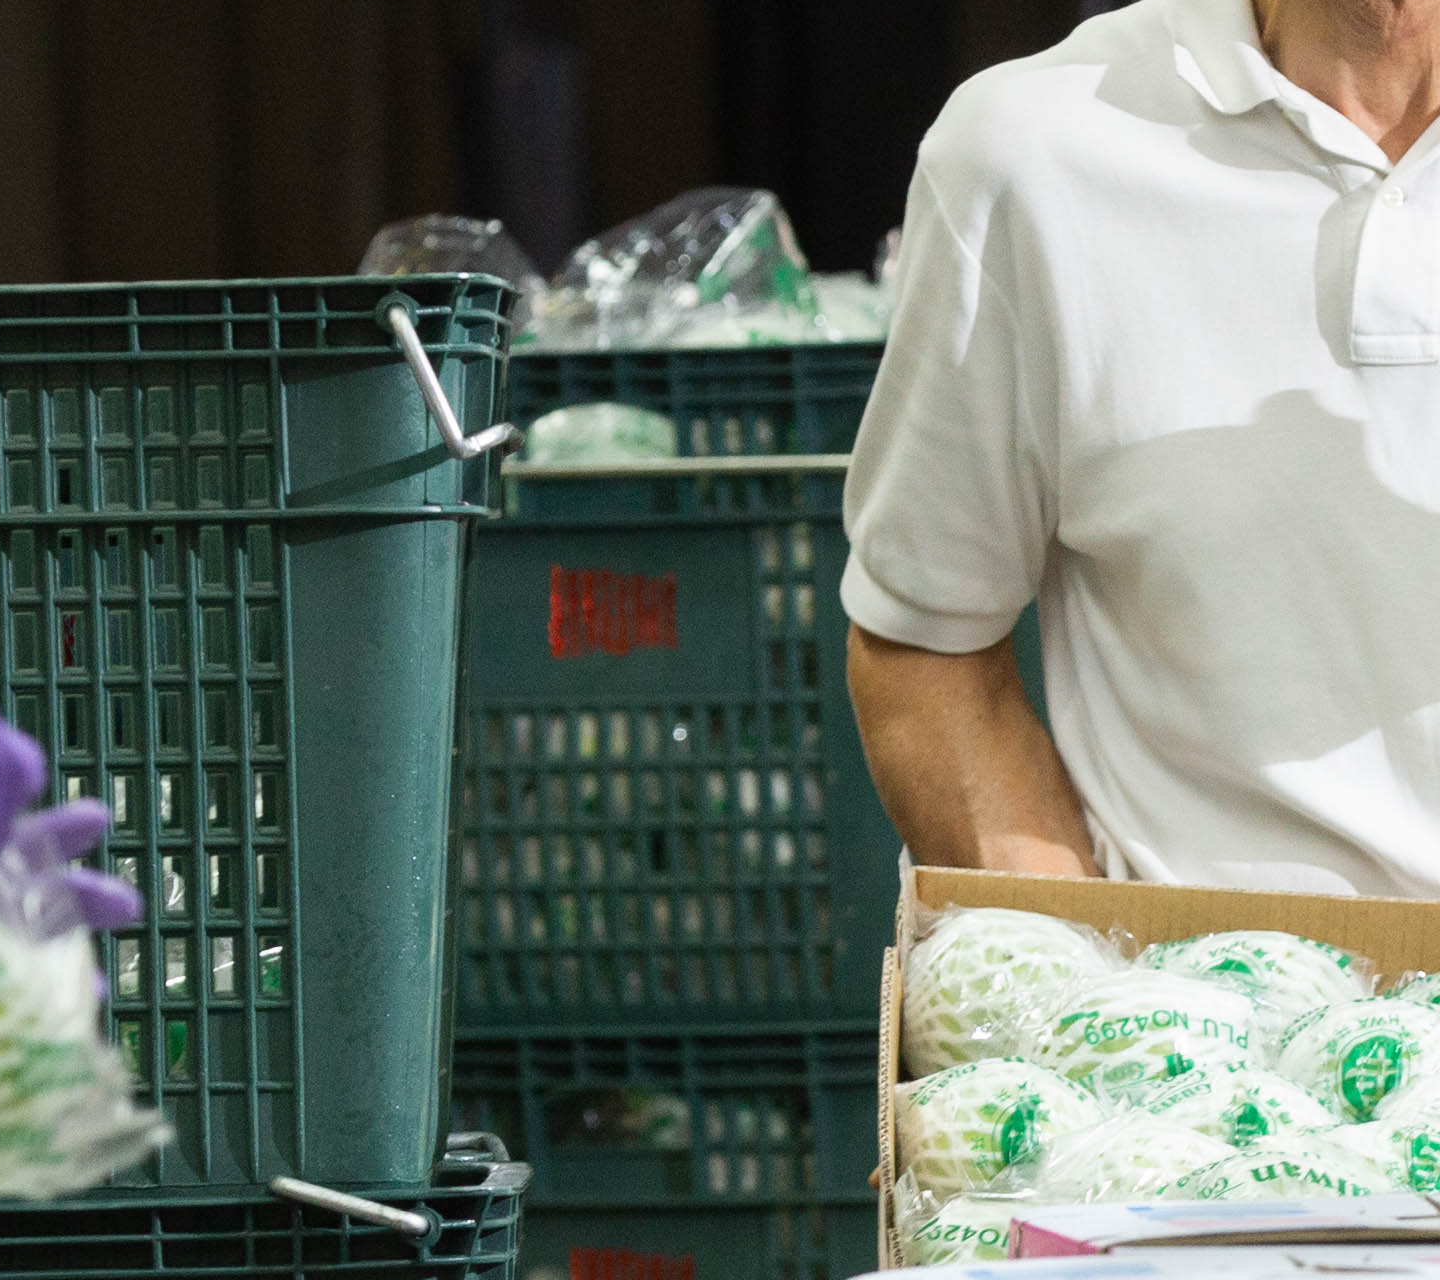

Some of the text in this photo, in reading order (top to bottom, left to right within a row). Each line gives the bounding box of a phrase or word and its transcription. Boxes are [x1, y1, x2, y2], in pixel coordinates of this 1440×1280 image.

[1084, 1009, 1249, 1050] PLU NO4299
[1250, 1160, 1372, 1197] aiwan
